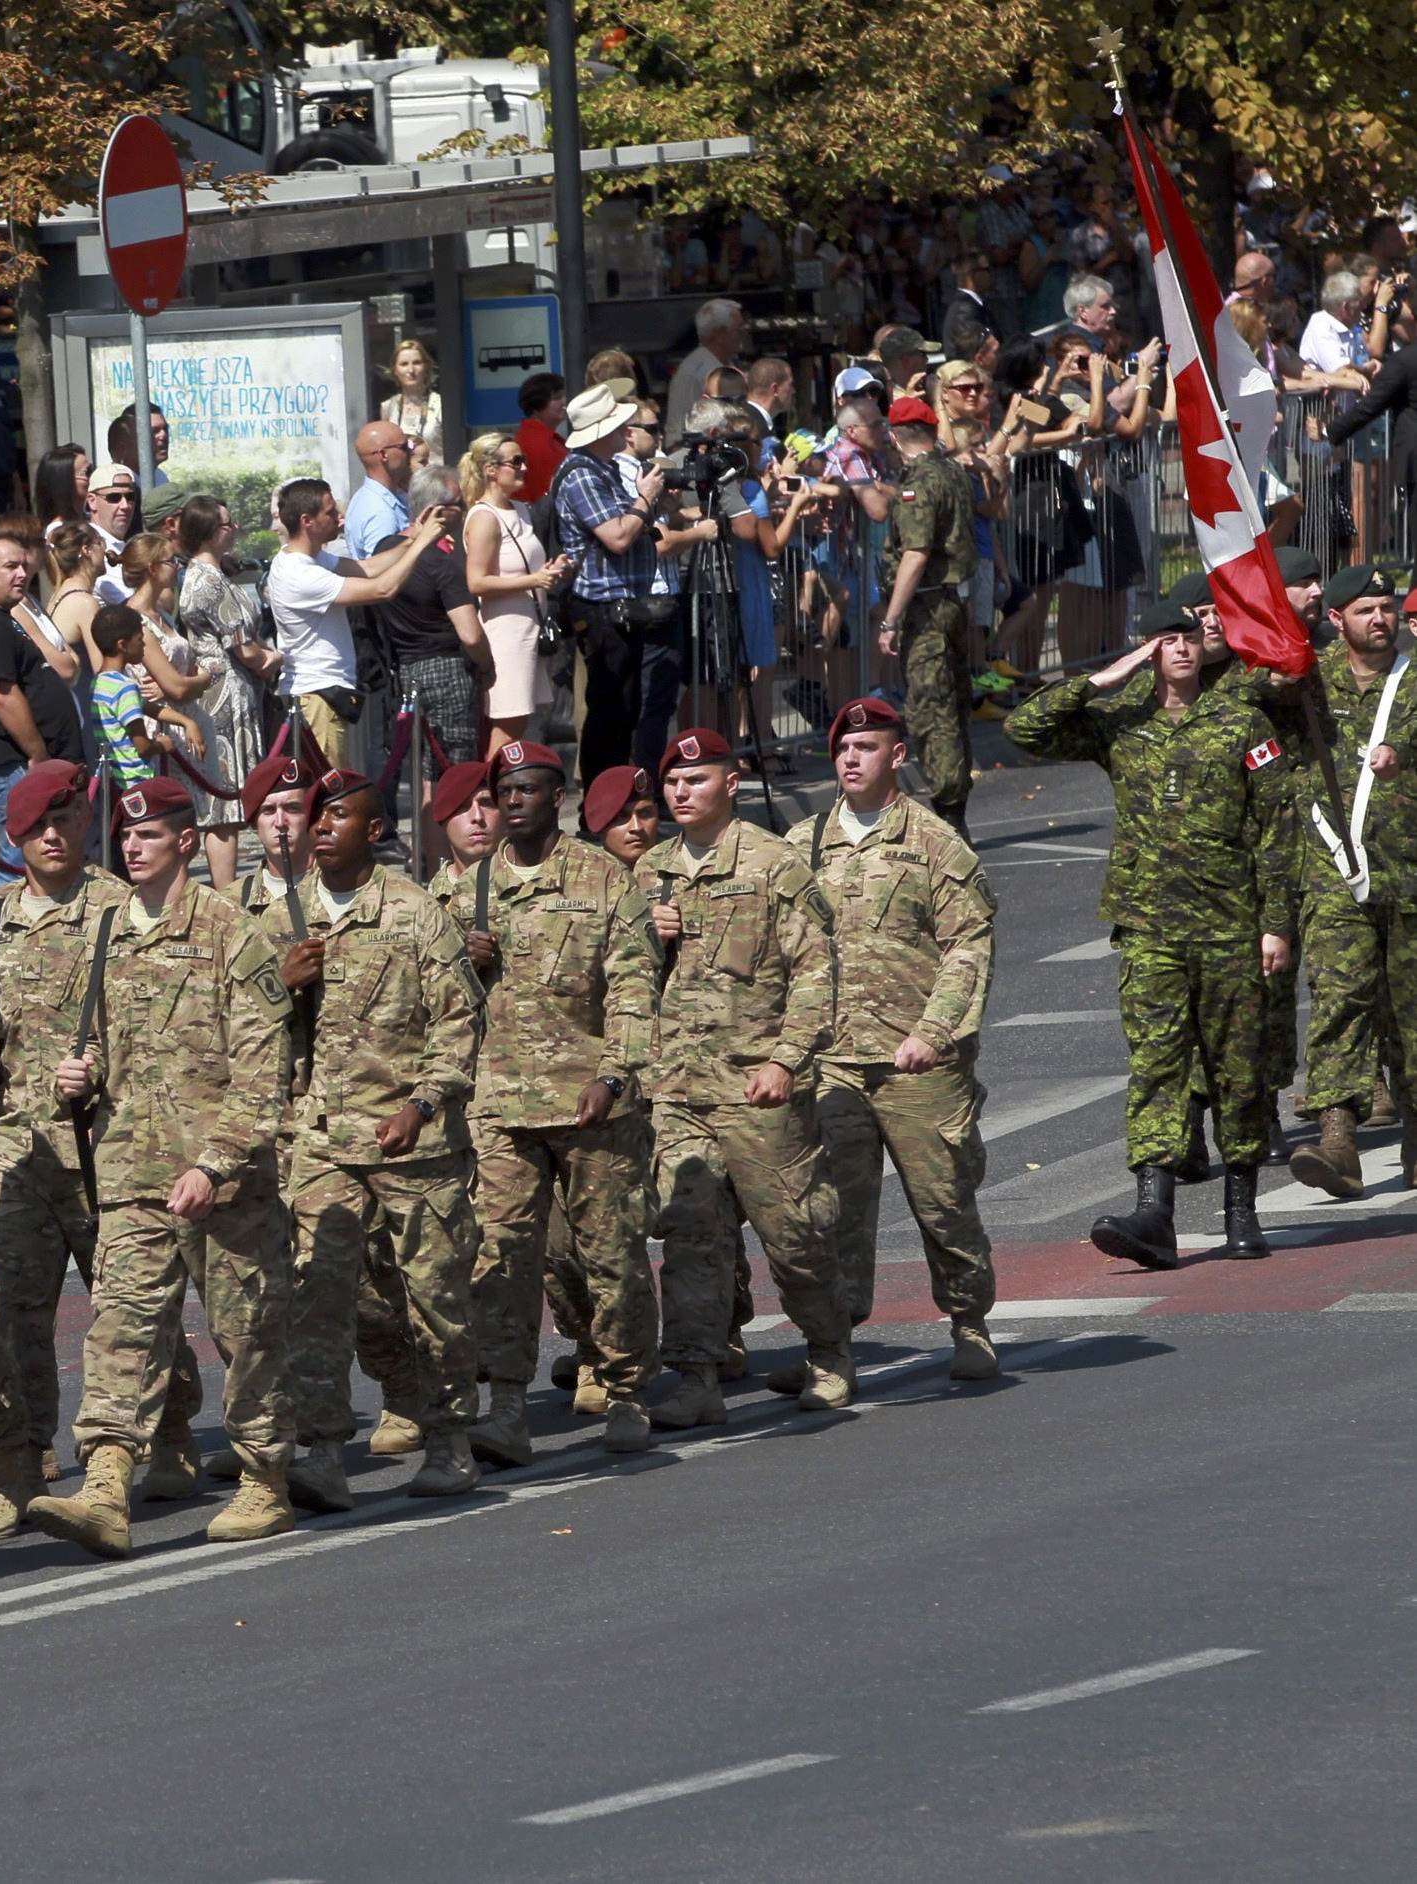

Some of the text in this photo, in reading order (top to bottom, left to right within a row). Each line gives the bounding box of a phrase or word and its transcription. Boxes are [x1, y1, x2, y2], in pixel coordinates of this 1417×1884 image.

[113, 356, 253, 389] NAPIĘKNIEJSZA
[154, 382, 330, 418] NASZYCH PRZYGÓD?
